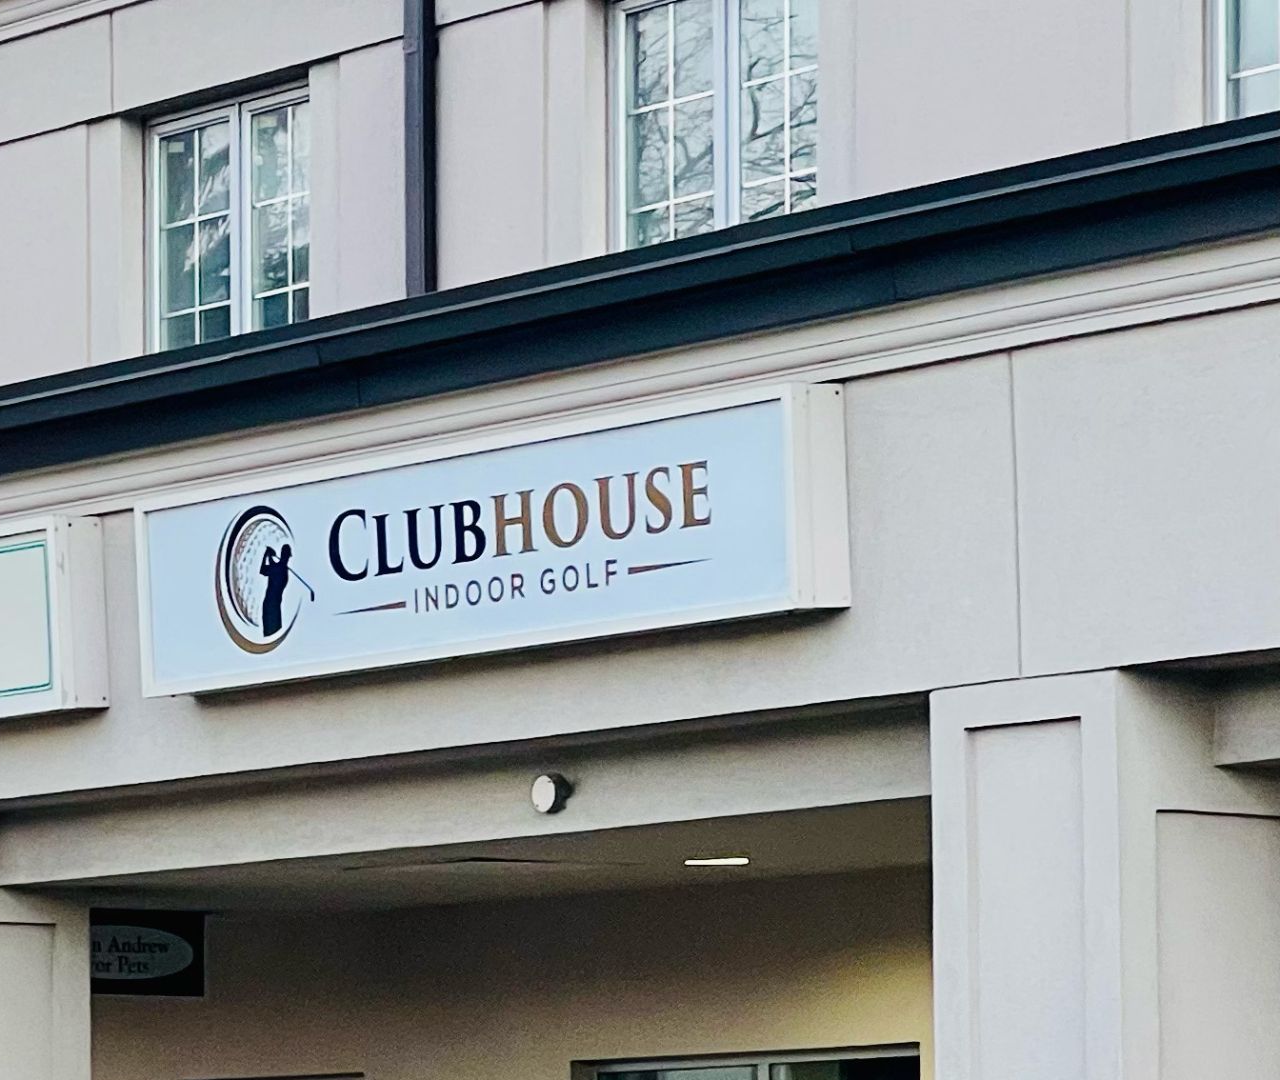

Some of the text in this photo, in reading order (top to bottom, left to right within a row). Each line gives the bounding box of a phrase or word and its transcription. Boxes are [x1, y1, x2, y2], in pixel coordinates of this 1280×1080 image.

[328, 460, 713, 582] CLUBHOUSE
[414, 559, 619, 614] INDOOR GOLF
